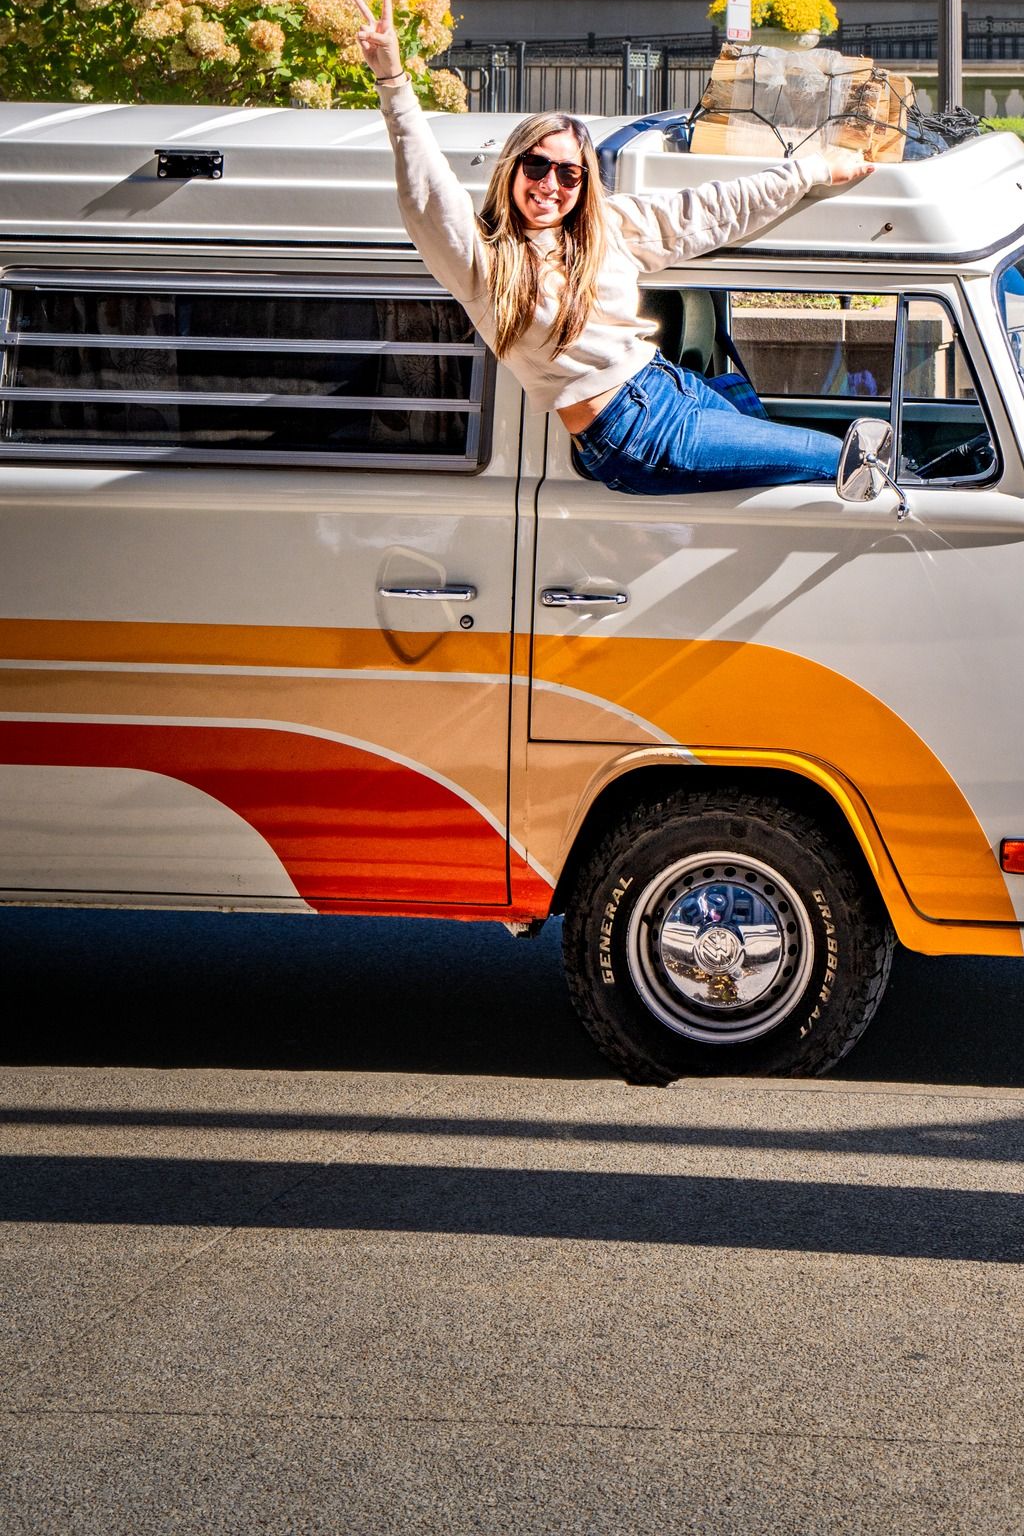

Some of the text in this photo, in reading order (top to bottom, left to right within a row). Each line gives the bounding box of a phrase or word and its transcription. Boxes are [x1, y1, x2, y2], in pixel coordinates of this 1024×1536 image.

[600, 876, 634, 984] GENERAL
[800, 889, 838, 1040] GRABBER A/T
